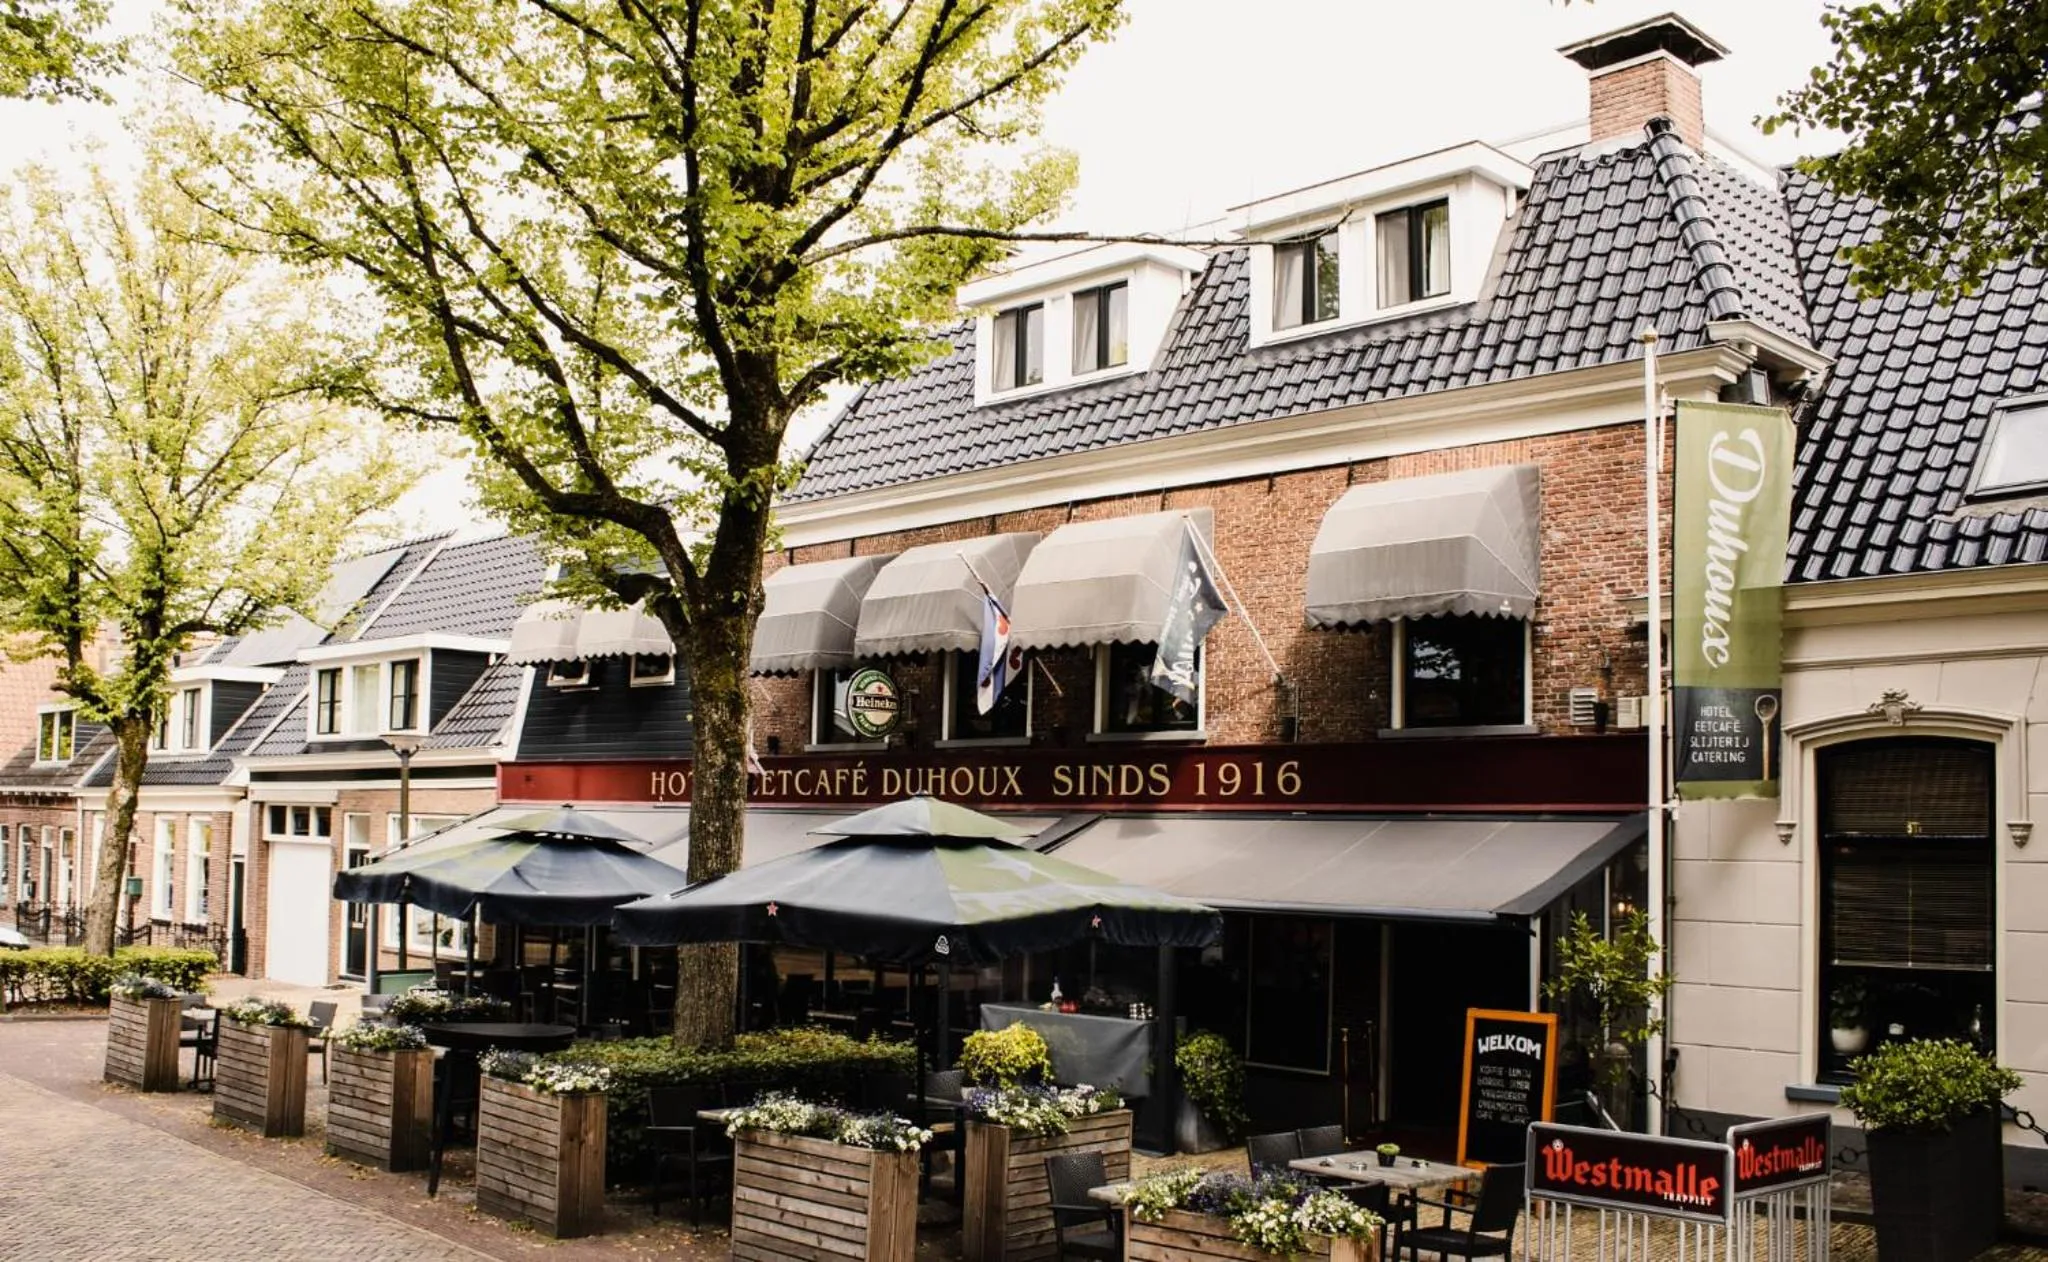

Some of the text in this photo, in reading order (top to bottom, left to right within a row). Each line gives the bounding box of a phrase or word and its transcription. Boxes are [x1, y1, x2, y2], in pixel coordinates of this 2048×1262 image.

[1702, 428, 1766, 669] Duhoux
[1700, 705, 1734, 718] HOTEL
[1689, 735, 1750, 748] SLIJTERIJ
[1691, 750, 1746, 763] CATERING
[752, 760, 869, 796] ETCAFÉ
[882, 766, 1024, 796] DUHOUX
[1052, 763, 1171, 796] SINDS
[1194, 761, 1302, 796] 1916
[1477, 1034, 1542, 1060] WELKOM
[1542, 1143, 1720, 1200] Westmalle
[1736, 1135, 1825, 1180] Westmalle
